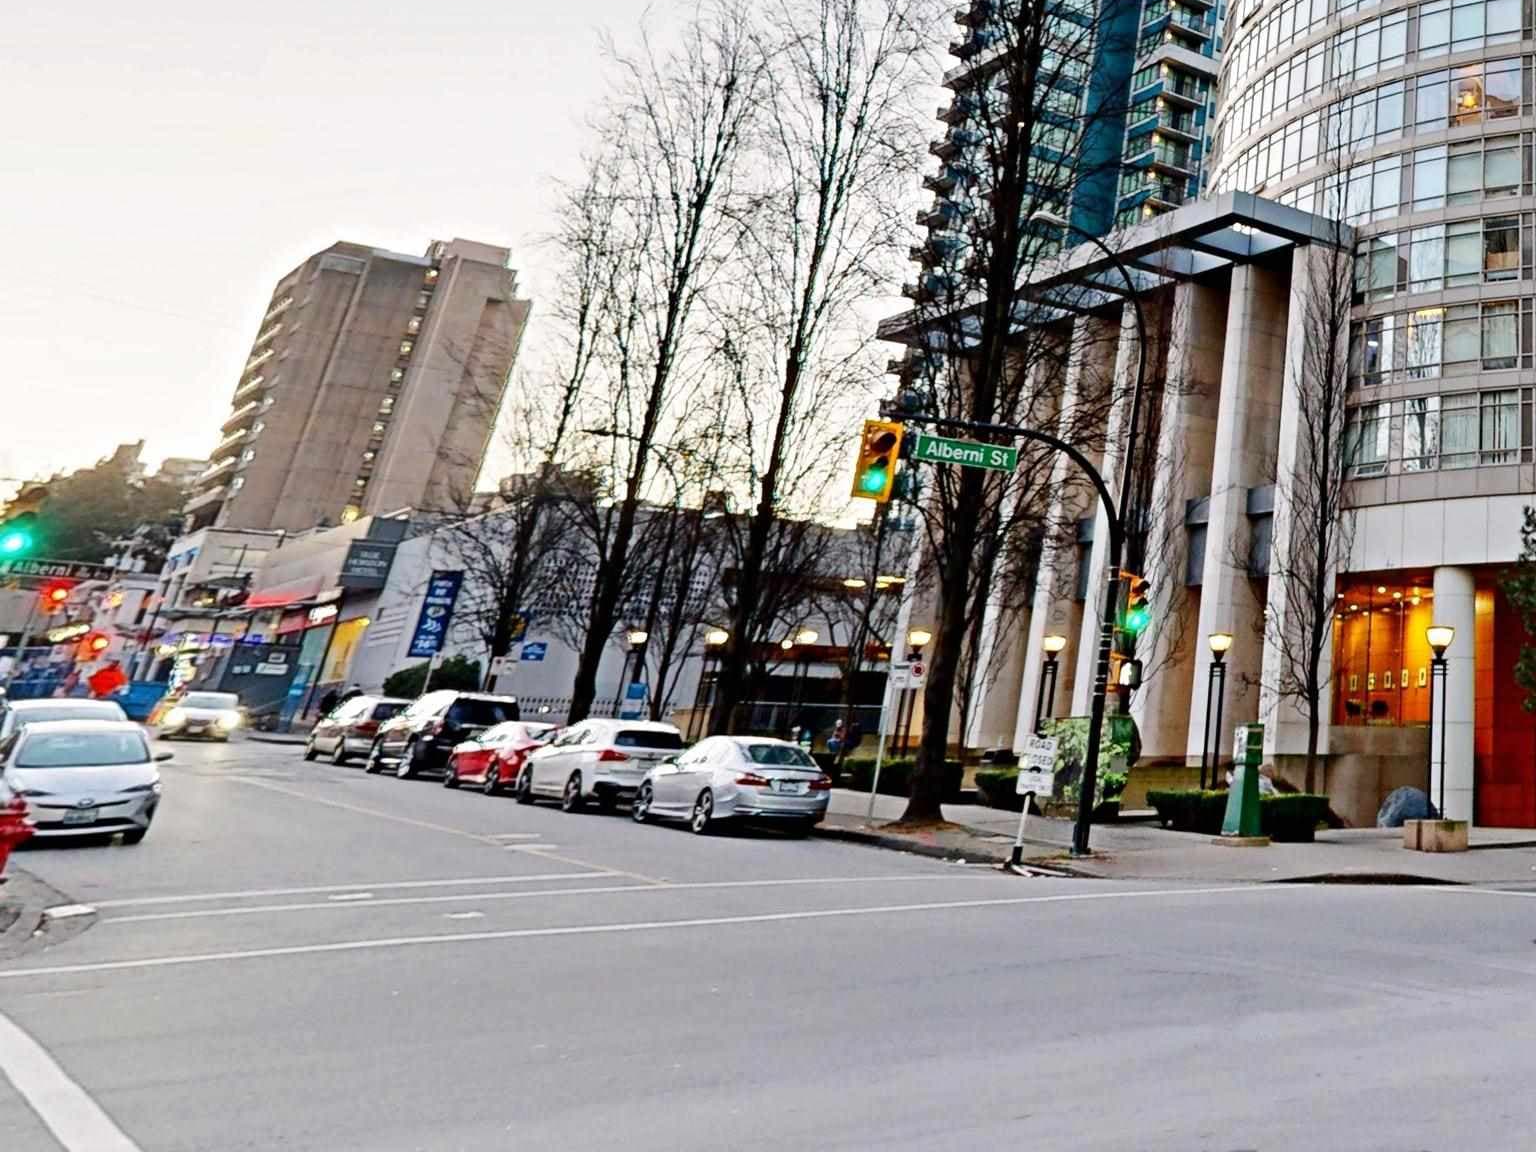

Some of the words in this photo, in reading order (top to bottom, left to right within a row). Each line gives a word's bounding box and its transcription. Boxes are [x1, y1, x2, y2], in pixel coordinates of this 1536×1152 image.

[926, 440, 984, 463] Alberni
[990, 450, 1009, 467] St
[12, 560, 73, 577] Alberni
